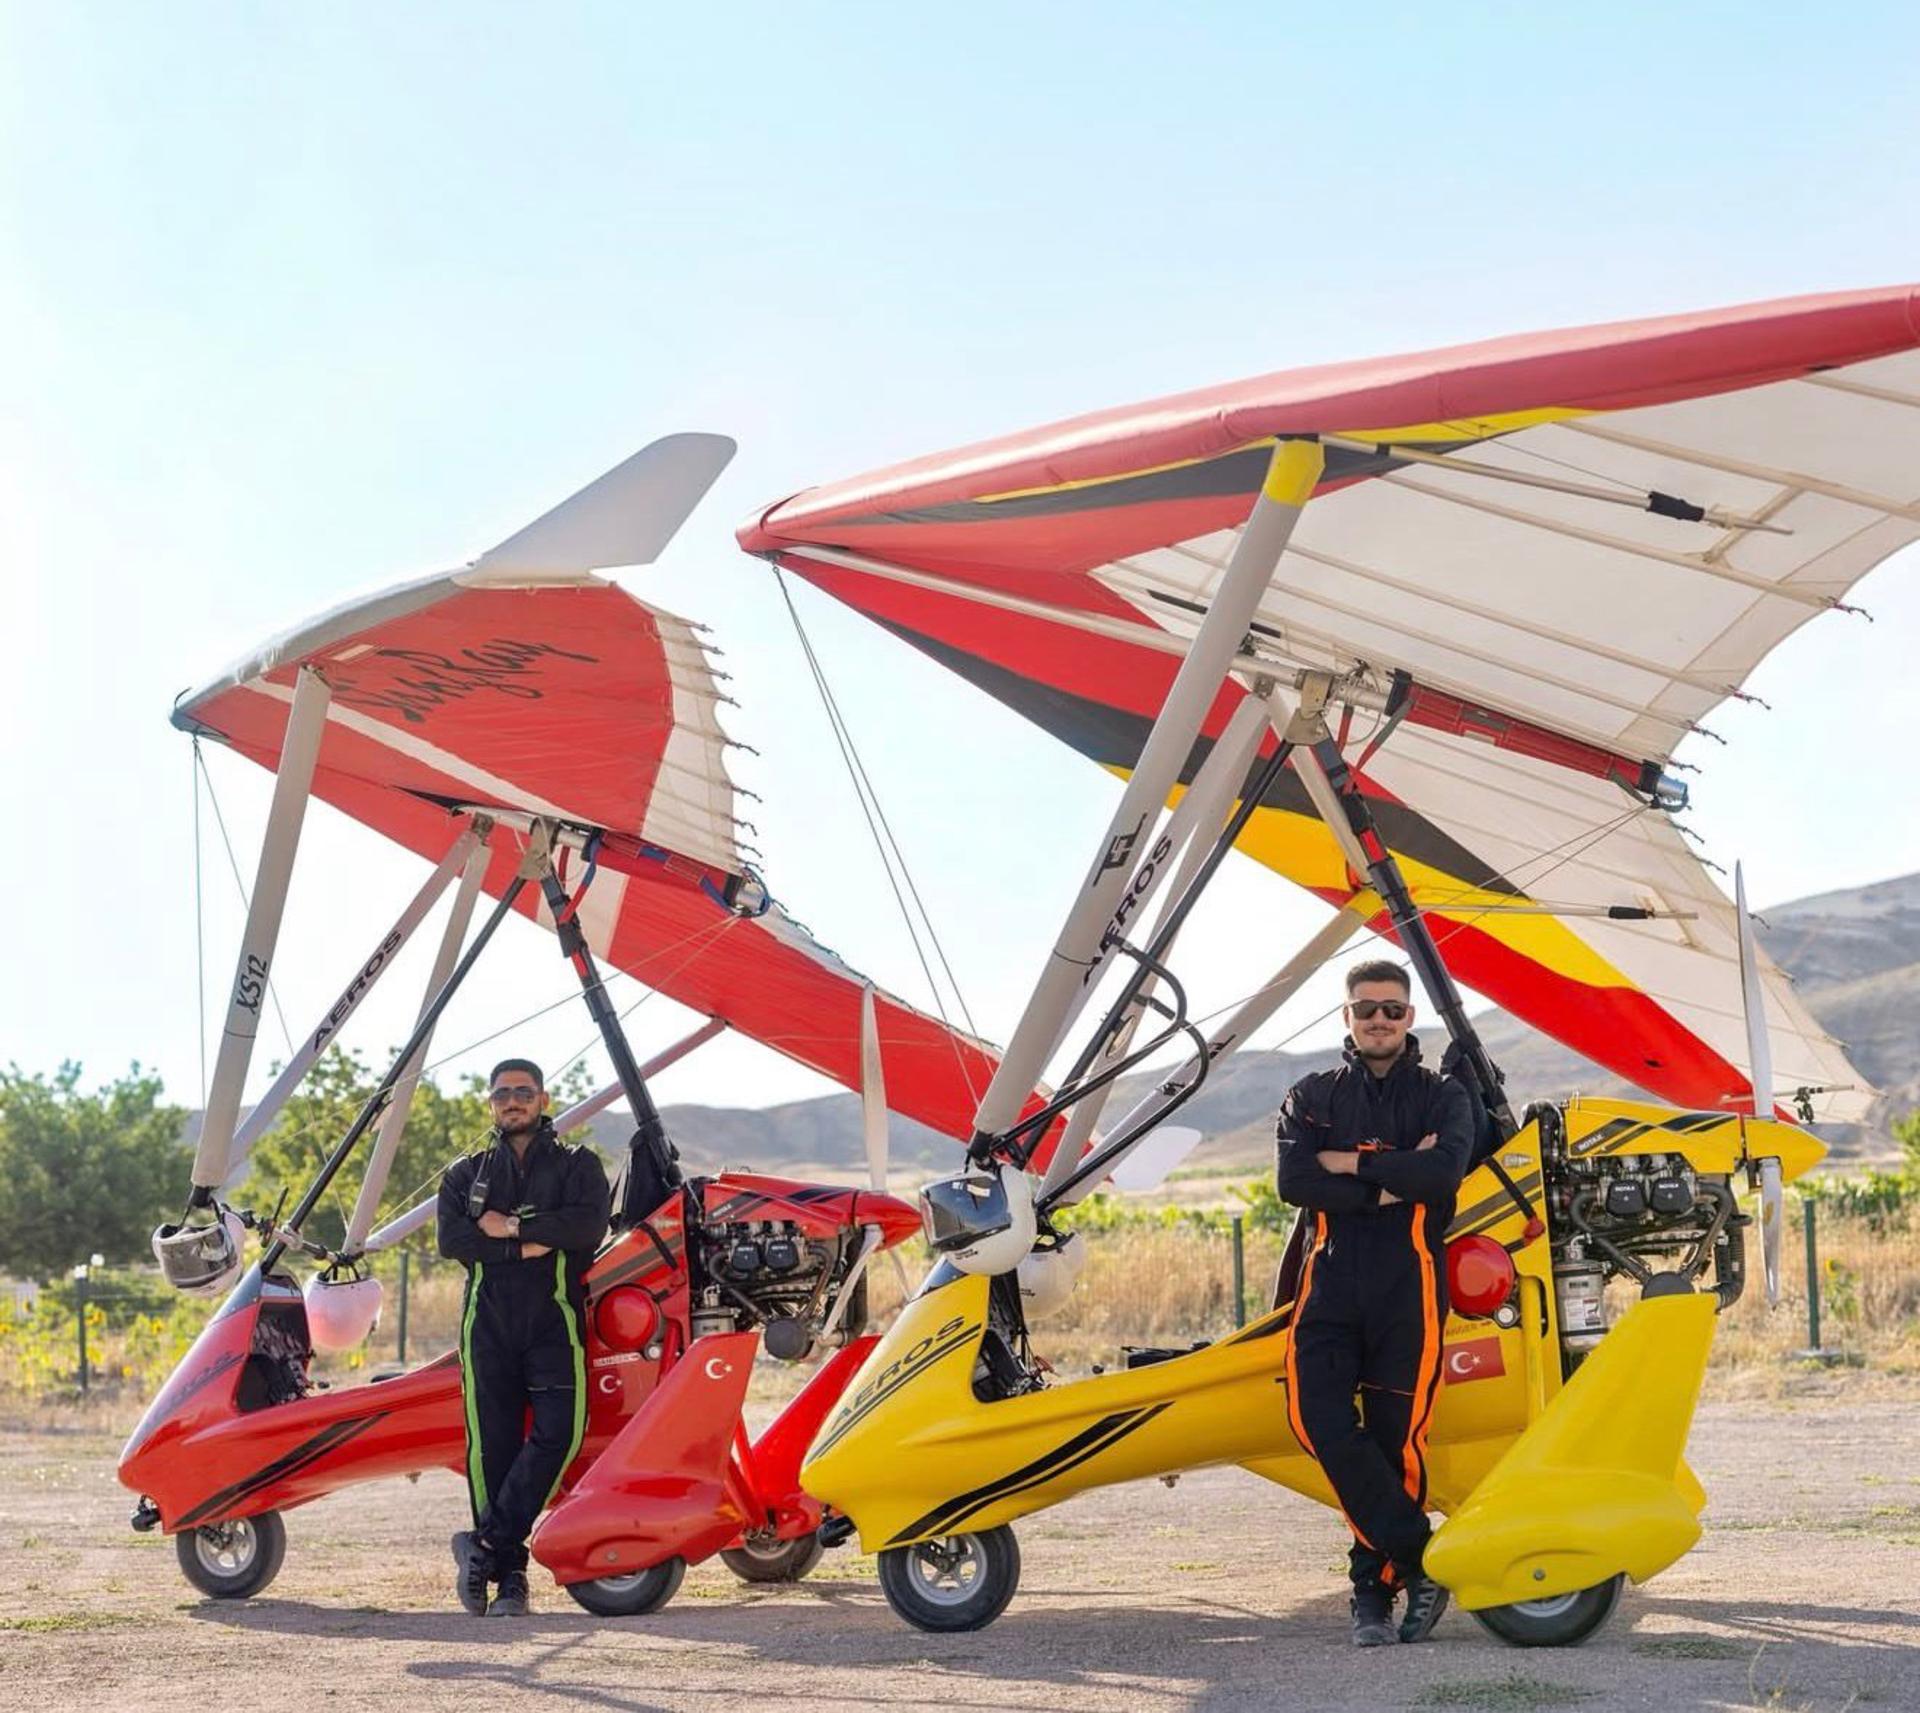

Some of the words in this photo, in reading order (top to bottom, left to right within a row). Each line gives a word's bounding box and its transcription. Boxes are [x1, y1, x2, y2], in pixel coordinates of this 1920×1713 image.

[1083, 834, 1174, 987] AEROS
[236, 953, 268, 1015] XS12
[314, 930, 402, 1053] AEROS
[831, 1315, 966, 1431] AEROS
